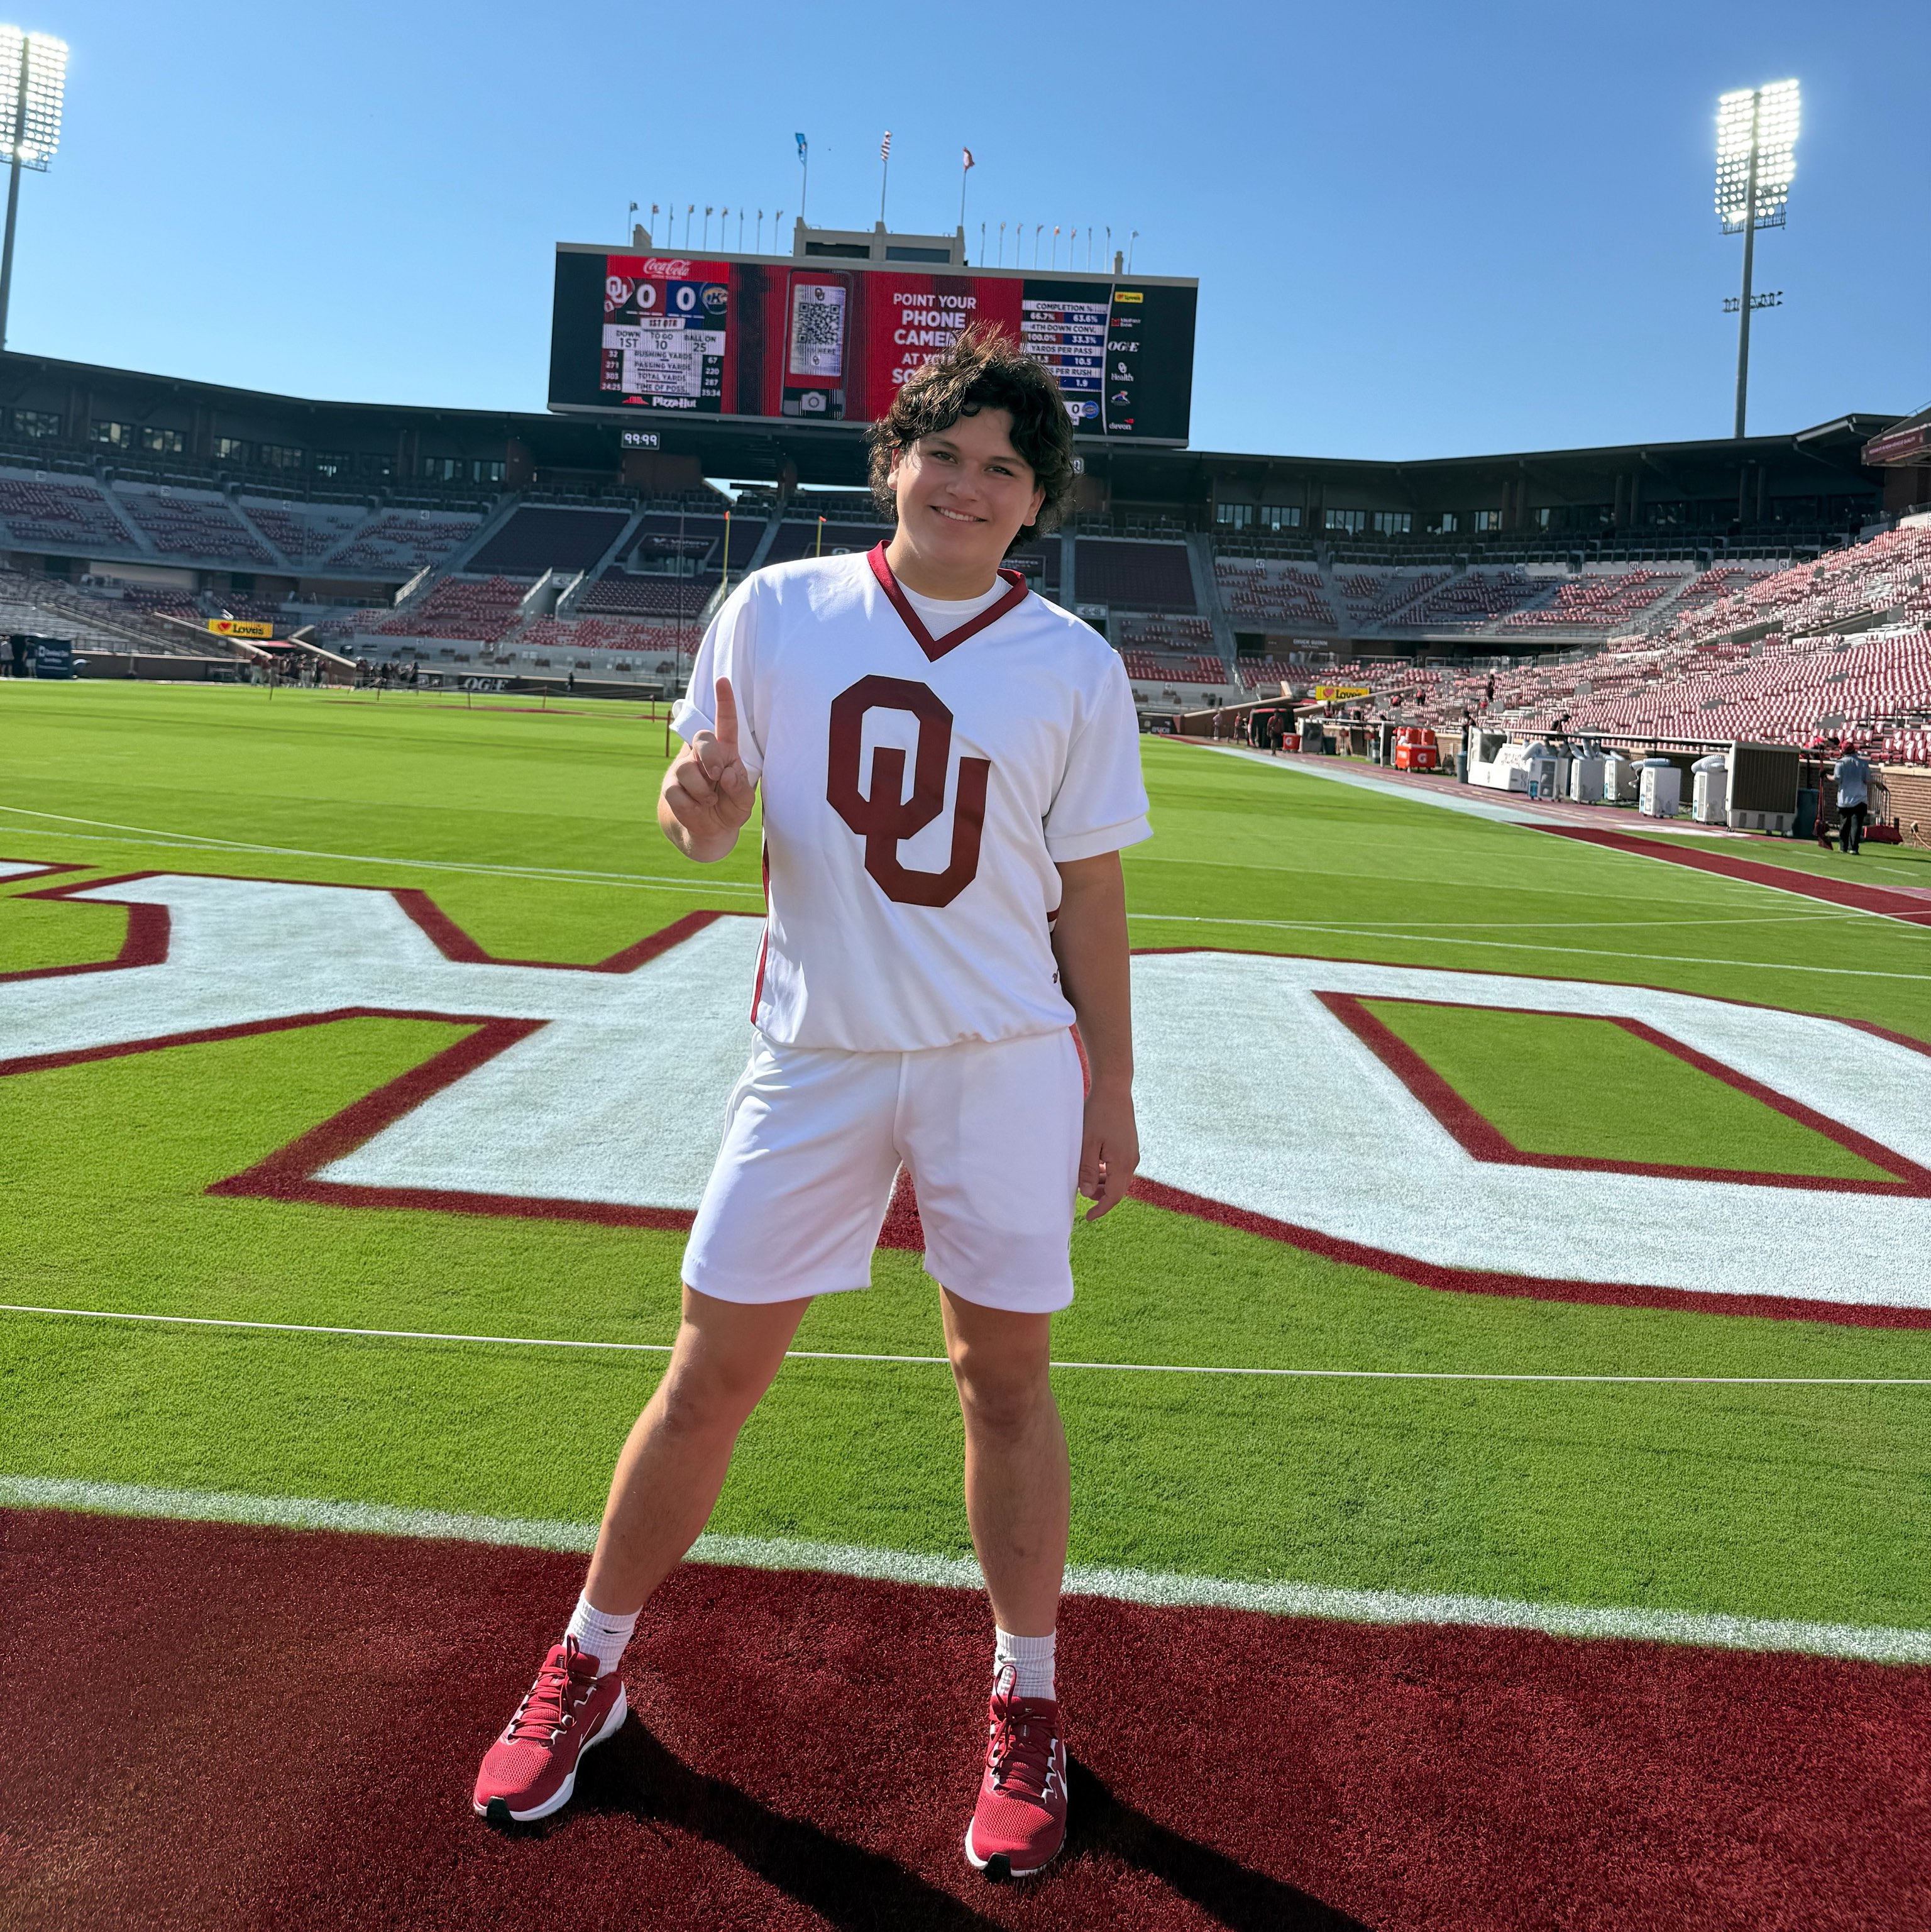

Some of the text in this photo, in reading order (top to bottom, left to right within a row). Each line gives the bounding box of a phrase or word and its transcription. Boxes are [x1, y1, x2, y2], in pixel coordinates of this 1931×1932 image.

[606, 276, 629, 304] OU
[637, 284, 656, 309] 0
[676, 286, 696, 311] 0
[893, 293, 976, 309] POINT YOUR
[1037, 303, 1085, 311] COMPLETION
[902, 309, 966, 328] PHONE
[620, 338, 639, 348] 1ST
[656, 340, 668, 350] 10
[894, 329, 955, 347] CAMER
[693, 343, 707, 352] 25
[901, 353, 920, 365] AT
[1072, 404, 1079, 414] 0
[827, 674, 991, 908] OU
